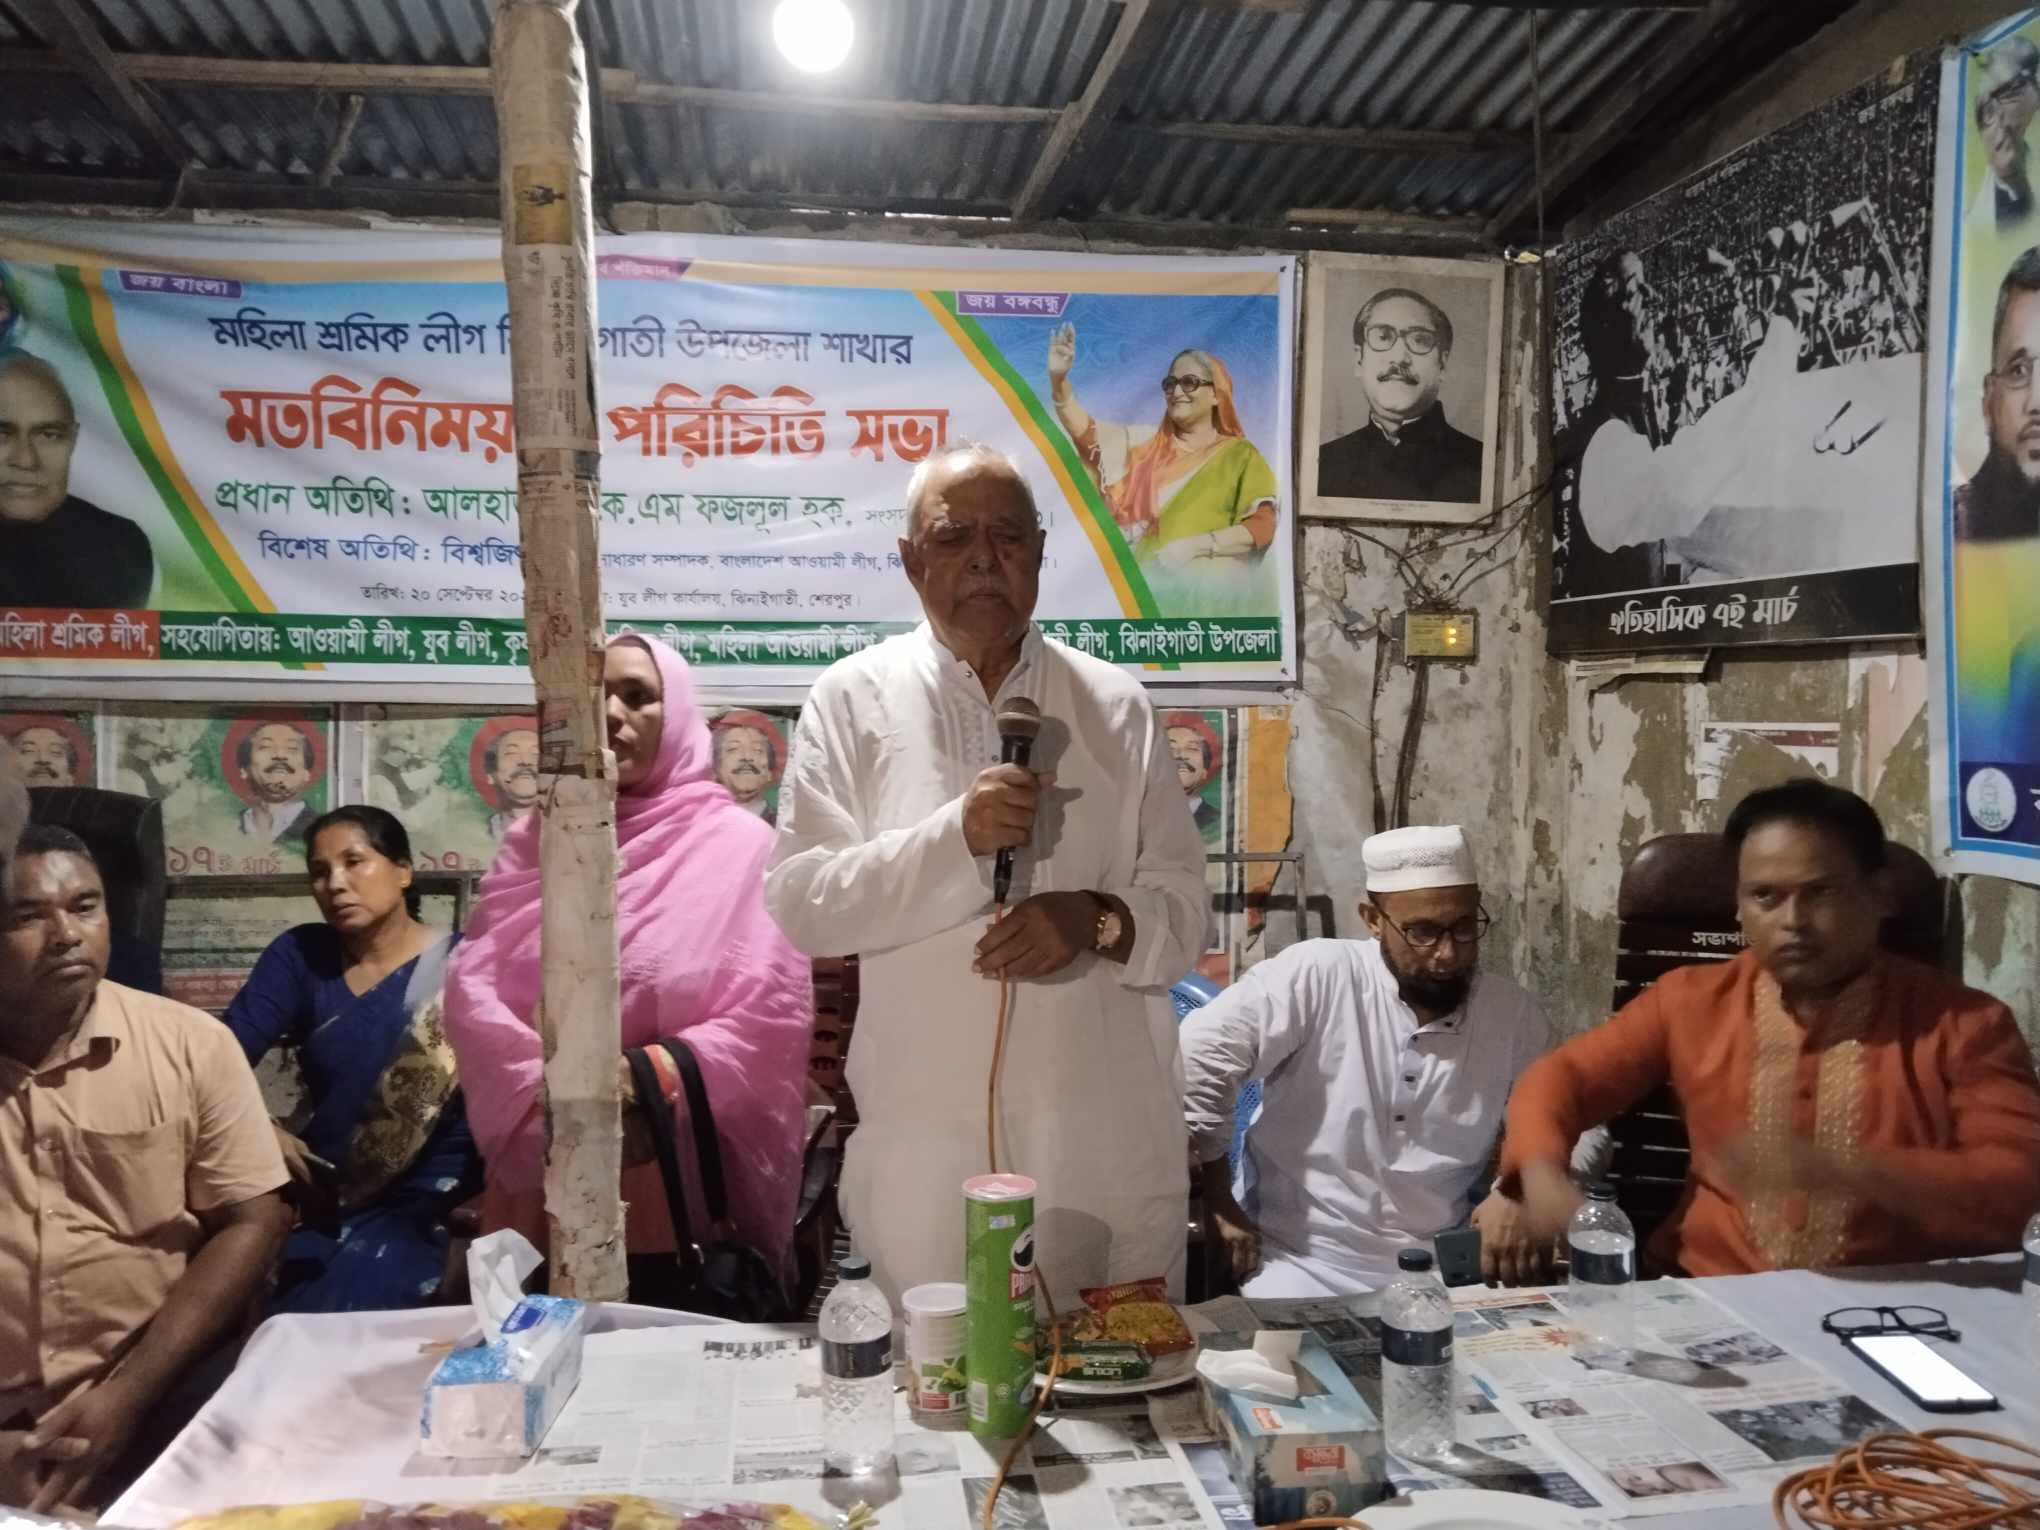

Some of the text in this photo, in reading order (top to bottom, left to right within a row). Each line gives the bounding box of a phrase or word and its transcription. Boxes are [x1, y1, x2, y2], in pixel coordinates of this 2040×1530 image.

[172, 277, 230, 295] বাংলা
[964, 294, 1060, 314] জয় বঙ্গবন্ধু
[207, 306, 306, 350] মহিলা
[314, 312, 409, 352] শ্রমিক
[418, 312, 487, 354] লীগ
[676, 319, 811, 362] উপজেলা
[819, 333, 913, 364] শাখার
[219, 373, 950, 468] মতবিনিময় পরিচিতি সভা
[215, 479, 296, 514] প্রধান
[257, 529, 329, 561] বিশেষ
[720, 553, 784, 568] বাংলাদেশ
[790, 551, 846, 569] আওয়ামী
[411, 588, 430, 600] ২০
[436, 586, 494, 602] সেপ্টেম্বর
[618, 591, 638, 608] যুব
[642, 587, 667, 604] লীগ
[1609, 599, 1707, 635] ঐতিহাসিক
[1752, 585, 1800, 625] মার্চ
[51, 613, 104, 651] শ্রমিক
[110, 613, 155, 657] লীগ,
[286, 618, 368, 656] আওয়ামী
[372, 619, 416, 662] লীগ,
[421, 629, 451, 664] যুব
[455, 620, 499, 664] লীগ,
[705, 624, 759, 663] মহিলা
[1119, 622, 1204, 659] ঝিনাইগাতী
[1208, 621, 1279, 655] উপজেলা
